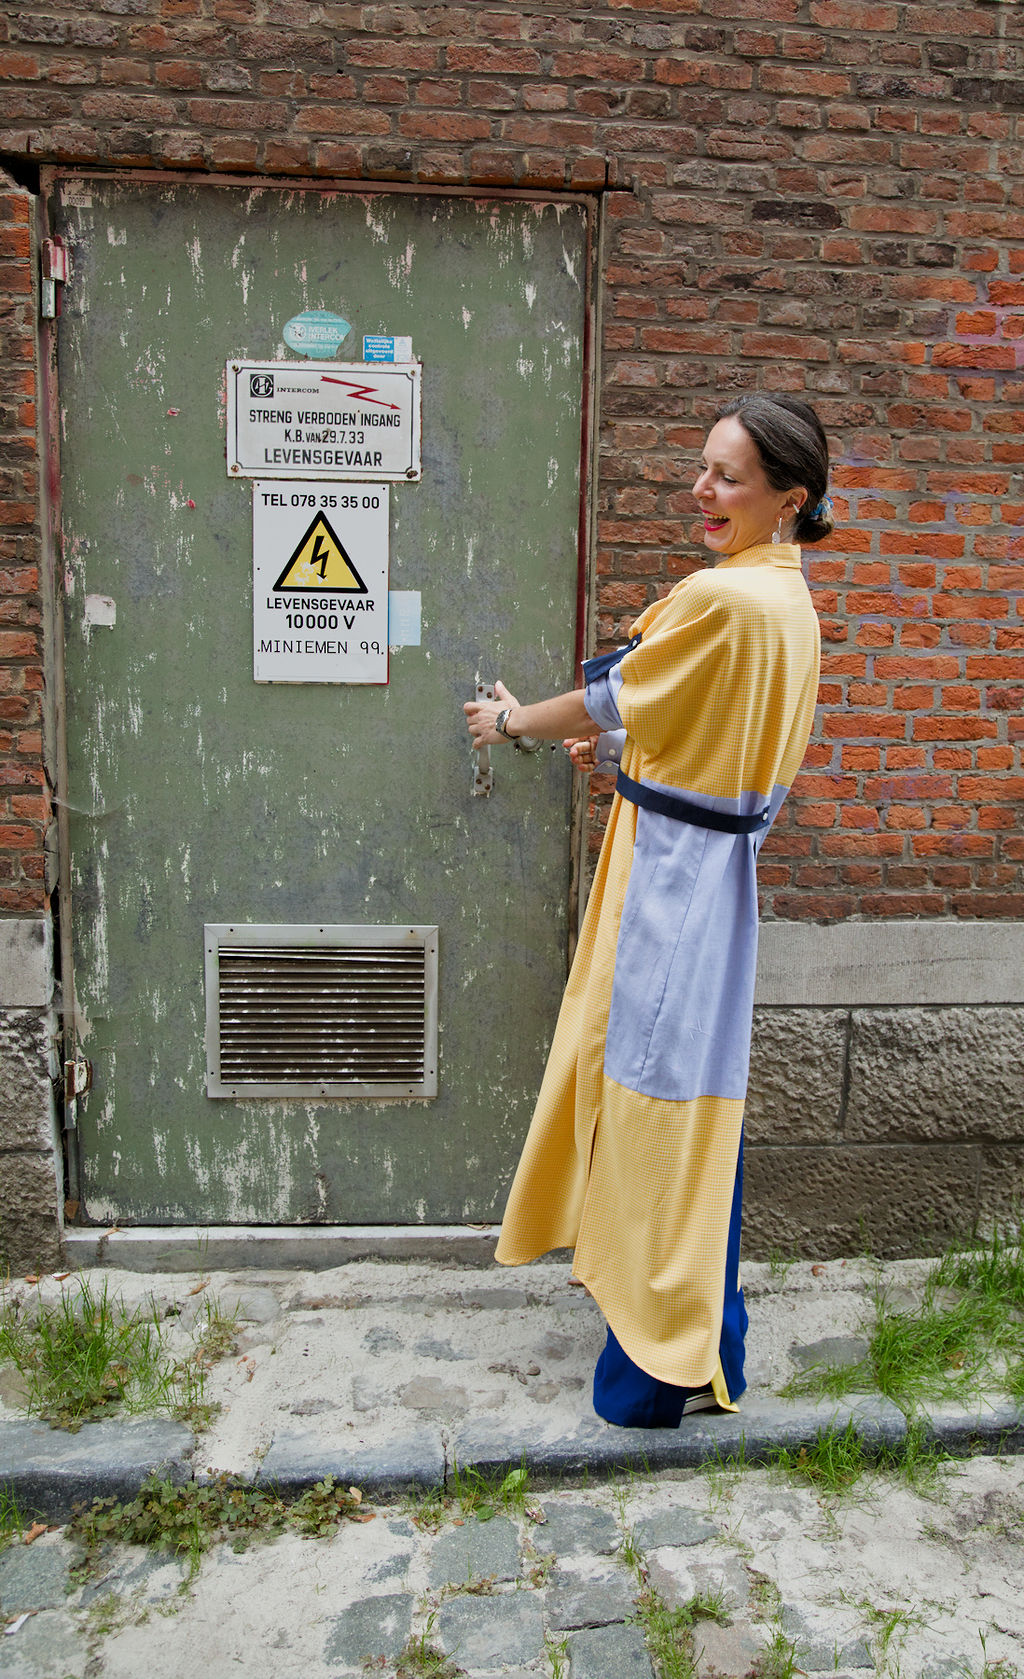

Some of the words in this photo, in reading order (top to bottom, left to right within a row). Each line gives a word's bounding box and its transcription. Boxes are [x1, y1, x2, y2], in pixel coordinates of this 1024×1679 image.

[249, 409, 293, 424] STRENG
[297, 411, 357, 427] VERBODEN
[360, 413, 401, 428] INGANG
[321, 430, 365, 444] 29.7.33
[264, 448, 382, 467] LEVENSGEVAAR
[261, 493, 288, 507] TEL
[290, 494, 317, 508] 078
[319, 495, 338, 508] 35
[340, 496, 359, 509] 35
[361, 496, 380, 509] 00
[266, 597, 375, 612] LEVENSGEVAAR
[343, 615, 356, 630] V
